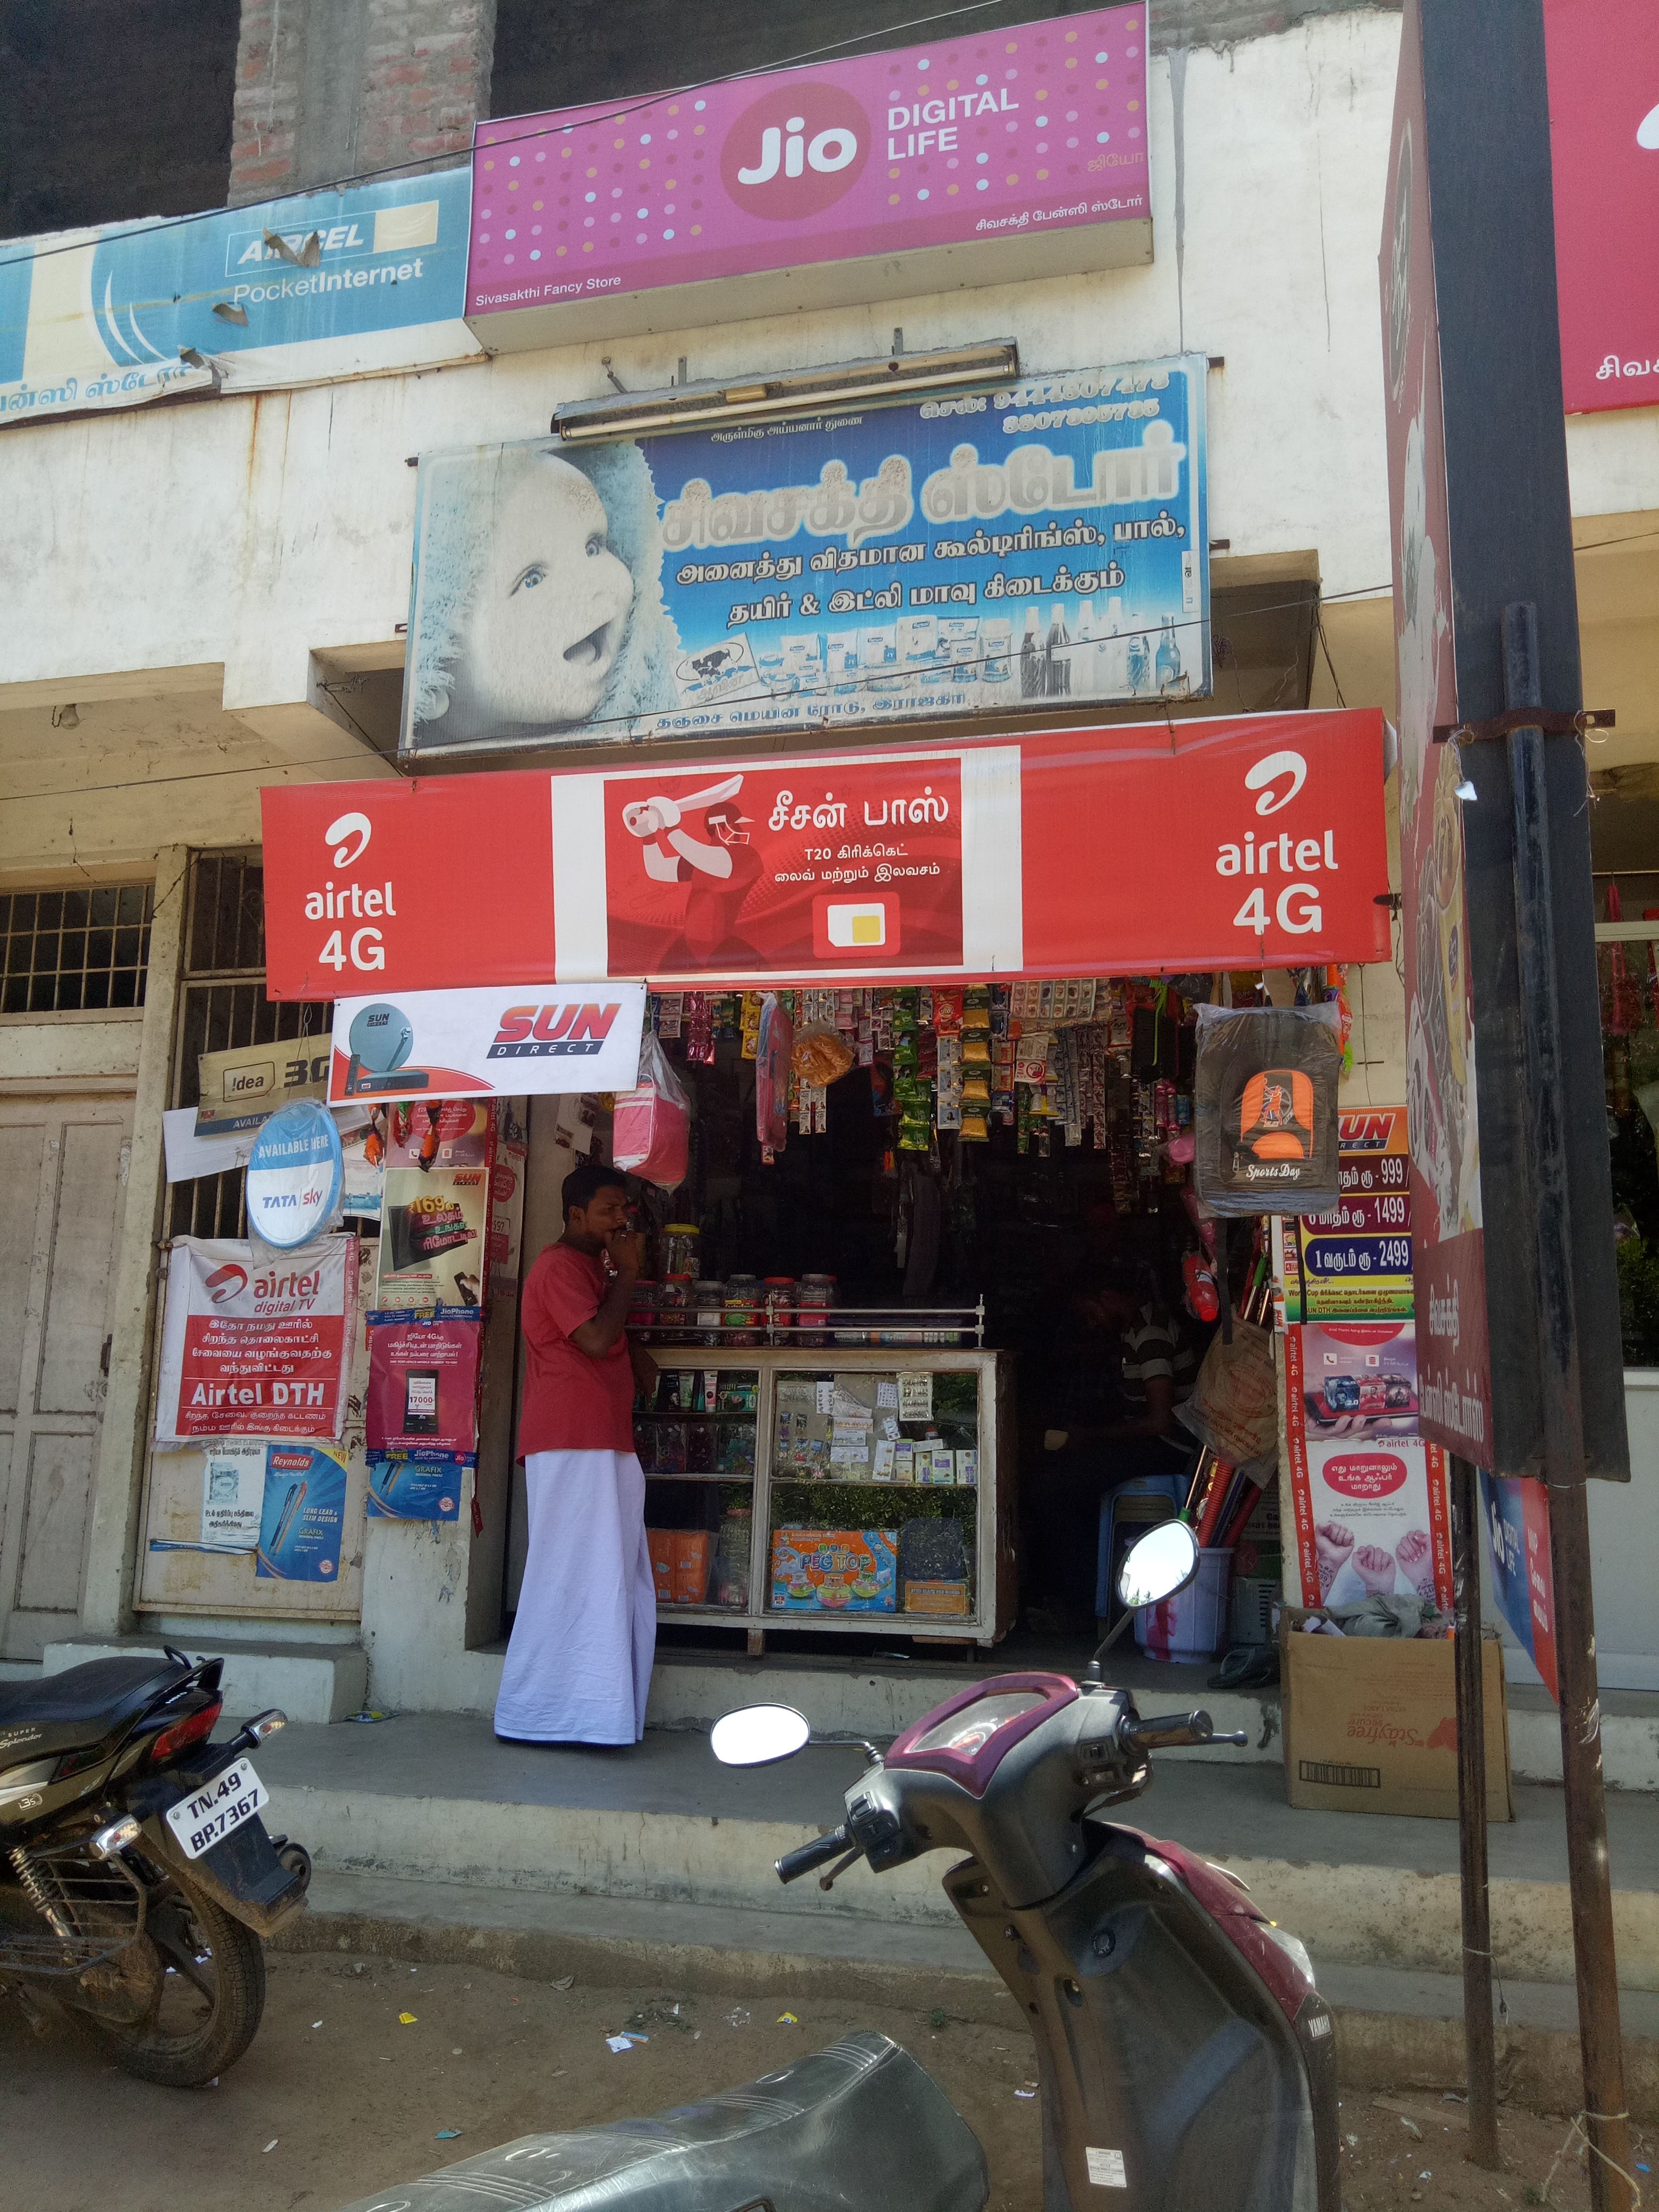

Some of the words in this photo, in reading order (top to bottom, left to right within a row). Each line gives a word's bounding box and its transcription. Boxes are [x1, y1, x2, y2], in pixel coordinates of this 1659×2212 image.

[888, 88, 1019, 131] DIGITAL
[738, 116, 857, 185] Jio
[888, 127, 958, 160] LIFE
[1087, 152, 1144, 173] ஜியோ
[975, 212, 1029, 231] சிவசக்தி
[1032, 202, 1087, 222] பேன்ஸி
[1091, 195, 1143, 214] ஸ்டோர்
[233, 258, 424, 305] PocketInternet
[475, 286, 540, 306] Sivasakthi
[544, 281, 583, 297] Fancy
[586, 275, 621, 290] Store
[825, 416, 863, 432] துணை
[662, 455, 913, 551] சிவசக்தி
[921, 420, 1187, 524] ஸ்டோர்
[676, 550, 803, 585] அனைத்து
[810, 541, 927, 573] விதமான
[1113, 510, 1186, 542] பால்,
[726, 592, 793, 629] தயிர்
[799, 593, 821, 616] &
[827, 582, 903, 614] இட்லி
[909, 580, 977, 607] மாவு
[983, 560, 1125, 600] கிடைக்கும்
[768, 790, 848, 831] சீசன்
[864, 786, 949, 825] பாஸ்
[805, 848, 832, 860] T20
[836, 843, 910, 860] கிரிக்கெட்
[1216, 830, 1339, 877] airtel
[774, 867, 816, 883] லைவ்
[821, 865, 869, 884] மற்றும்
[874, 861, 941, 882] இலவசம்
[305, 882, 396, 920] airtel
[1233, 883, 1322, 935] 4G
[319, 927, 385, 971] 4G
[368, 1013, 390, 1023] SUN
[494, 1003, 623, 1042] SUN
[496, 1043, 594, 1055] DIRECT
[1338, 1114, 1394, 1140] UN
[258, 1138, 309, 1158] AVAILABLE
[311, 1134, 329, 1150] HERE
[454, 1173, 482, 1182] SUN
[1246, 1164, 1279, 1180] Sports
[1279, 1163, 1301, 1180] Day
[262, 1194, 297, 1209] TATA
[1324, 1249, 1356, 1271] வருடம்
[1379, 1240, 1409, 1267] 2499
[254, 1270, 320, 1299] airtel
[254, 1300, 294, 1316] digital
[298, 1298, 315, 1311] TV
[208, 1319, 244, 1331] இதோ
[246, 1322, 275, 1333] நமது
[202, 1333, 237, 1345] சிறந்த
[240, 1333, 319, 1345] தொலைகாட்சி
[245, 1347, 332, 1360] வழங்குவதற்கு
[220, 1361, 295, 1375] வந்துவிட்டது
[1291, 1362, 1298, 1376] 4G
[191, 1382, 262, 1406] Airtel
[273, 1382, 325, 1406] DTH
[185, 1411, 209, 1421] சிறந்த
[1293, 1414, 1299, 1427] 4G
[1387, 1439, 1409, 1447] airtel
[1413, 1439, 1426, 1447] 4G
[273, 1456, 309, 1467] Reynolds
[333, 1451, 347, 1463] NEW
[414, 1449, 449, 1459] JioPhone
[1431, 1455, 1438, 1468] 4G
[1296, 1465, 1303, 1479] 4G
[1331, 1465, 1346, 1473] எது
[1350, 1463, 1397, 1473] மாறுனாலும்
[1364, 1472, 1392, 1483] ஆஃபர்
[1351, 1484, 1381, 1492] மாறாது
[1435, 1507, 1442, 1521] 4G
[1302, 1516, 1309, 1530] 4G
[800, 1553, 833, 1571] PEG
[836, 1553, 871, 1571] TOP
[1438, 1560, 1446, 1574] 4G
[1306, 1569, 1313, 1582] 4G
[0, 1733, 42, 1749] Splendor
[8, 1727, 36, 1738] SUPER
[1347, 1723, 1418, 1746] Stayfree
[187, 1772, 242, 1820] TN.49
[190, 1789, 258, 1853] BP.7367
[1308, 2014, 1331, 2038] YAMAHA
